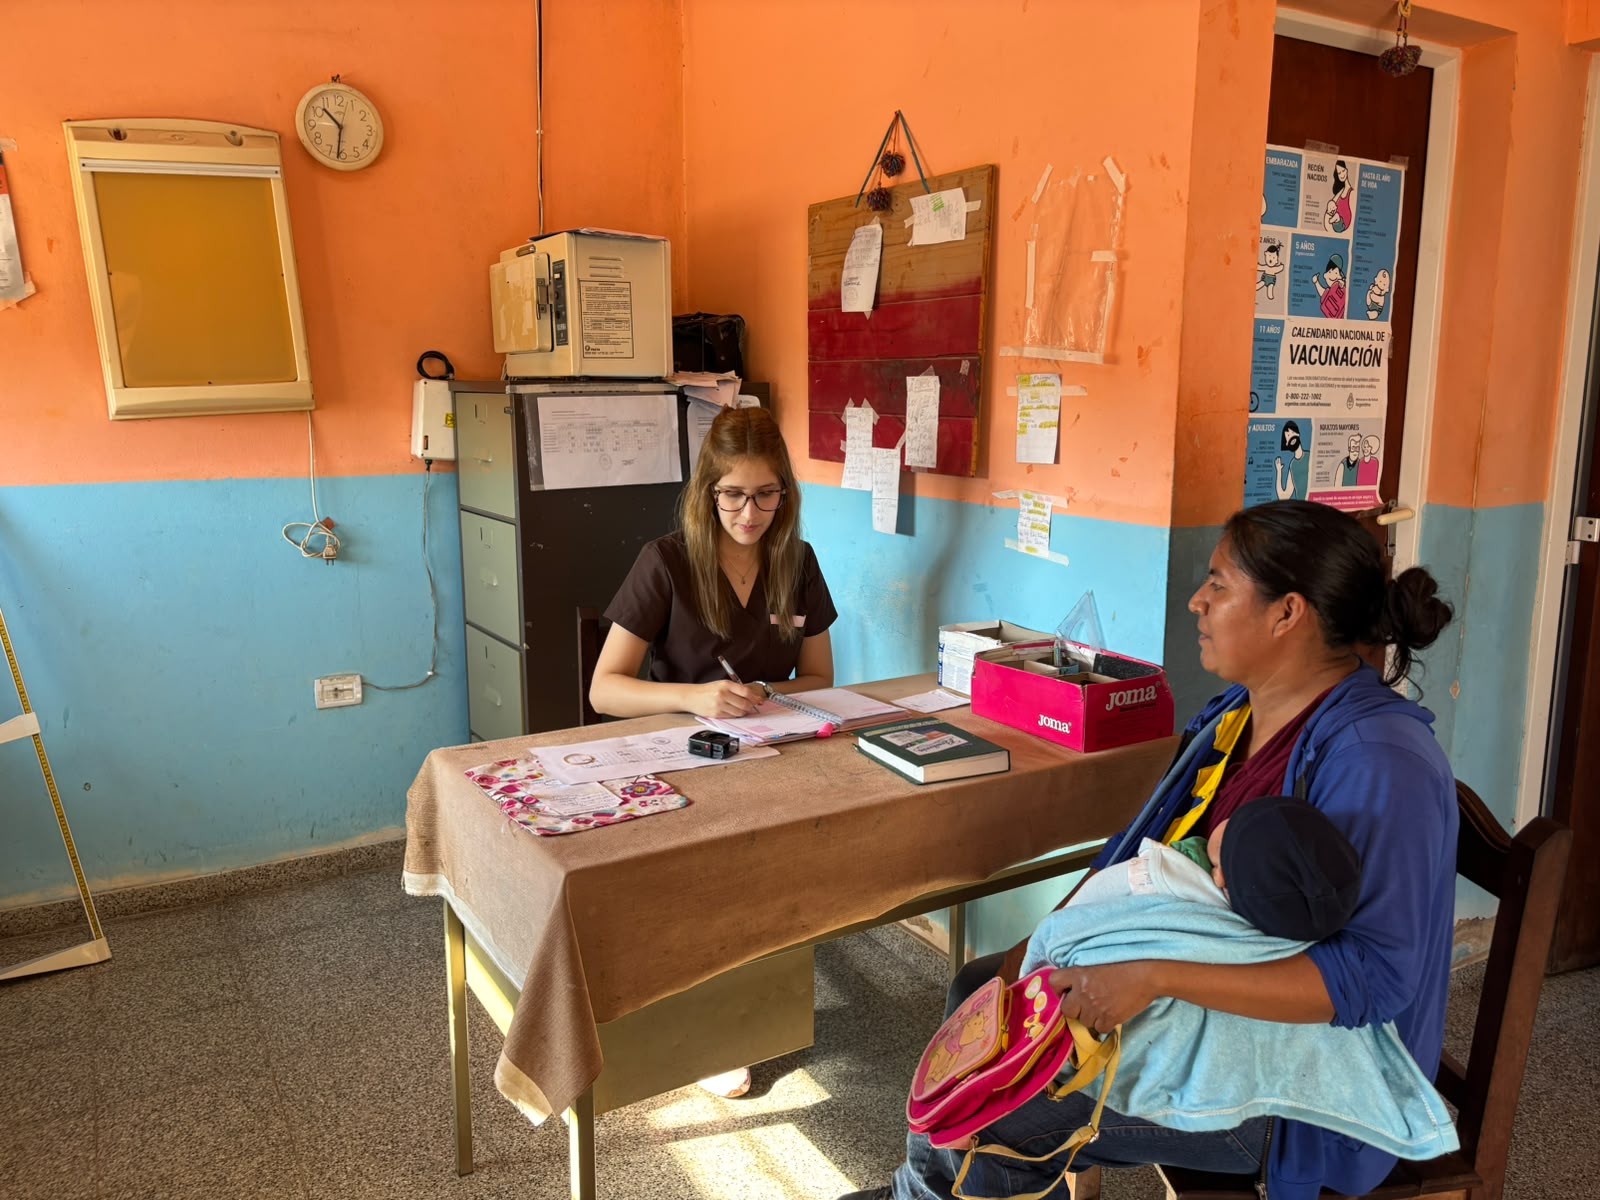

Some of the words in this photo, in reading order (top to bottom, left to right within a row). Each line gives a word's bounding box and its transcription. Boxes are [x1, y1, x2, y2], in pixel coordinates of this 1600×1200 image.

[322, 97, 329, 108] 11
[333, 94, 344, 107] 12
[312, 106, 324, 118] 10
[359, 110, 367, 122] 2
[308, 119, 316, 131] 9
[366, 125, 373, 137] 3
[314, 132, 322, 145] 8
[362, 139, 369, 150] 4
[326, 144, 333, 156] 7
[339, 148, 347, 160] 6
[353, 146, 360, 158] 5
[1308, 163, 1324, 172] RECIÉN
[1307, 173, 1327, 182] NACIDOS
[1362, 171, 1375, 180] HASTA
[1295, 241, 1300, 250] 5
[1300, 239, 1314, 251] AÑOS
[1259, 325, 1265, 333] 11
[1265, 324, 1280, 334] AÑOS
[1291, 326, 1338, 339] CALENDARIO
[1339, 329, 1374, 341] NACIONAL
[1376, 331, 1385, 341] DE
[1289, 343, 1383, 368] VACUNACIÓN
[1252, 424, 1276, 432] ADULTOS
[1319, 423, 1338, 431] ADULTOS
[1339, 423, 1360, 431] MAYORES
